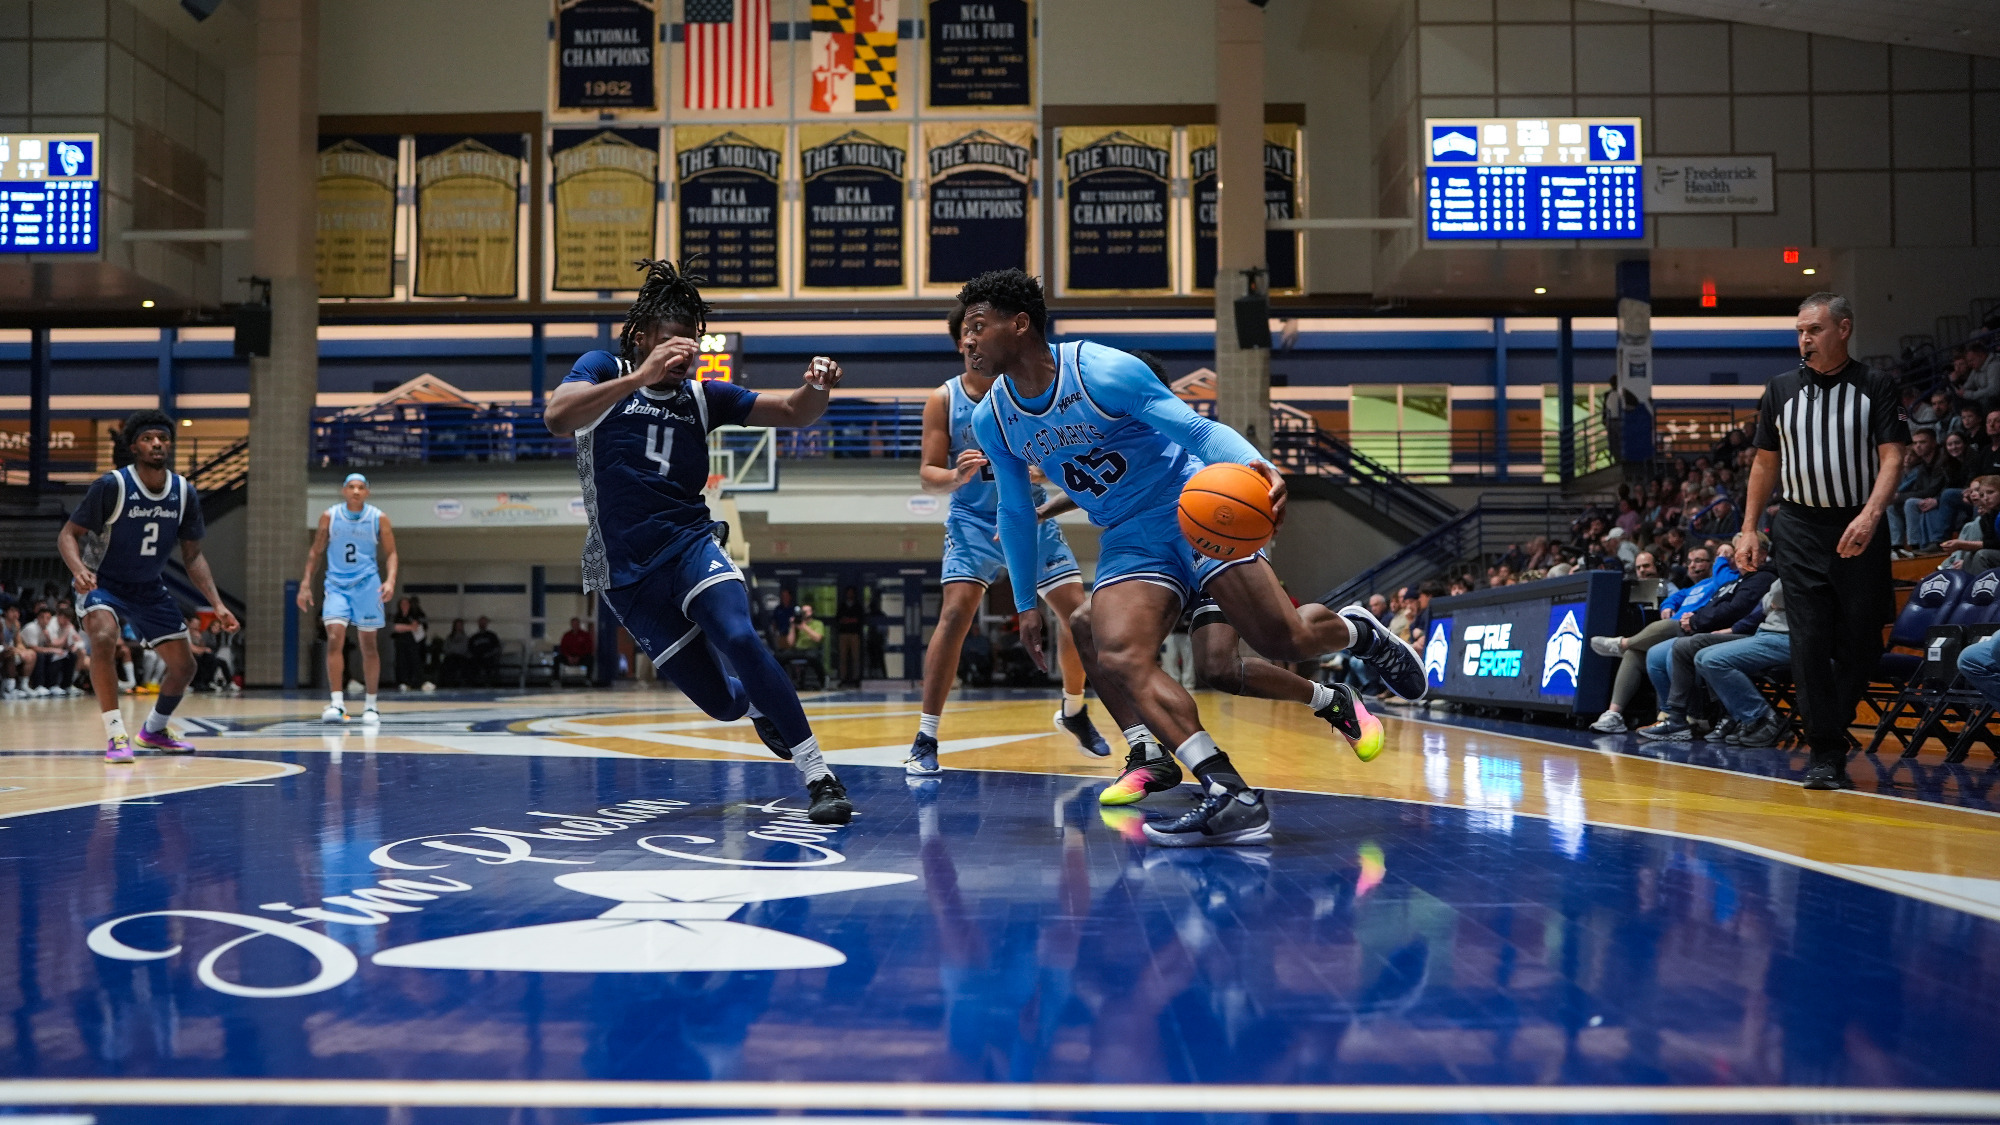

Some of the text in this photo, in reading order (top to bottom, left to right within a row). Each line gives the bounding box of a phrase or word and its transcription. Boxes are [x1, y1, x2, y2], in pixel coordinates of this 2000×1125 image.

[960, 5, 995, 21] NCAA
[574, 28, 640, 45] NATIONAL
[942, 24, 1015, 40] FINAL FOUR
[562, 48, 650, 67] CHAMPIONS
[584, 81, 632, 97] 1962
[679, 146, 780, 179] THE MOUNT
[804, 144, 904, 177] THE MOUNT
[930, 143, 1027, 175] THE MOUNT
[1067, 147, 1170, 178] THE MOUNT
[1192, 150, 1217, 178] TH
[1684, 166, 1758, 180] Frederick
[710, 188, 747, 205] NCAA
[835, 186, 871, 204] NCAA
[1684, 181, 1730, 194] Health
[687, 207, 771, 224] TOURNAMENT
[812, 205, 895, 222] TOURNAMENT
[934, 200, 1024, 220] CHAMPIONS
[1074, 203, 1164, 224] CHAMPIONS
[696, 354, 732, 382] 25
[622, 398, 662, 417] Saint
[1057, 391, 1083, 415] MAAC
[644, 424, 676, 478] 4
[1034, 427, 1059, 456] ST.
[1060, 446, 1128, 499] 45
[128, 504, 153, 519] Saint
[140, 522, 160, 556] 2
[345, 543, 357, 563] 2
[1478, 650, 1524, 678] SPORTS
[636, 797, 862, 868] Court
[86, 798, 691, 1000] Jim Phelan
